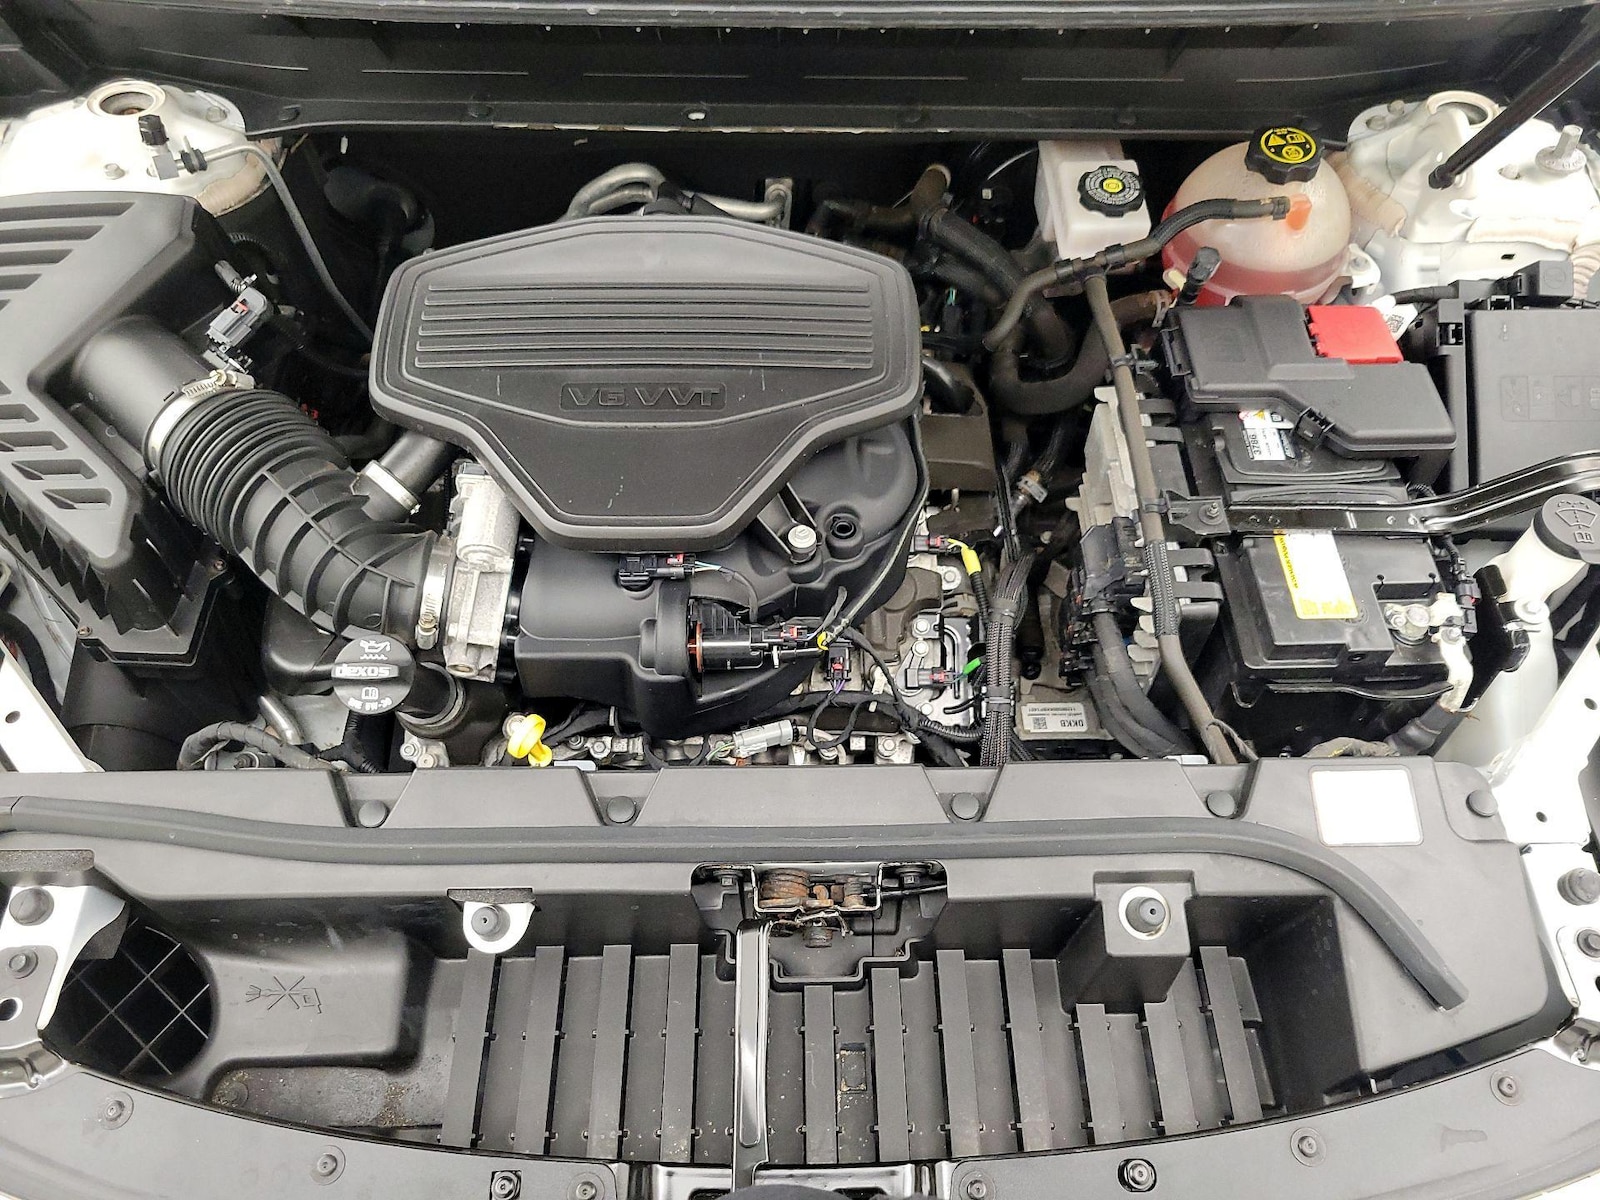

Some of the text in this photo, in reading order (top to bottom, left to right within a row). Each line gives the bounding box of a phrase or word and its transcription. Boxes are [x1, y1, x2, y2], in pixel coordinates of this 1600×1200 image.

[567, 386, 721, 407] V6 VVT
[335, 663, 391, 678] dexos
